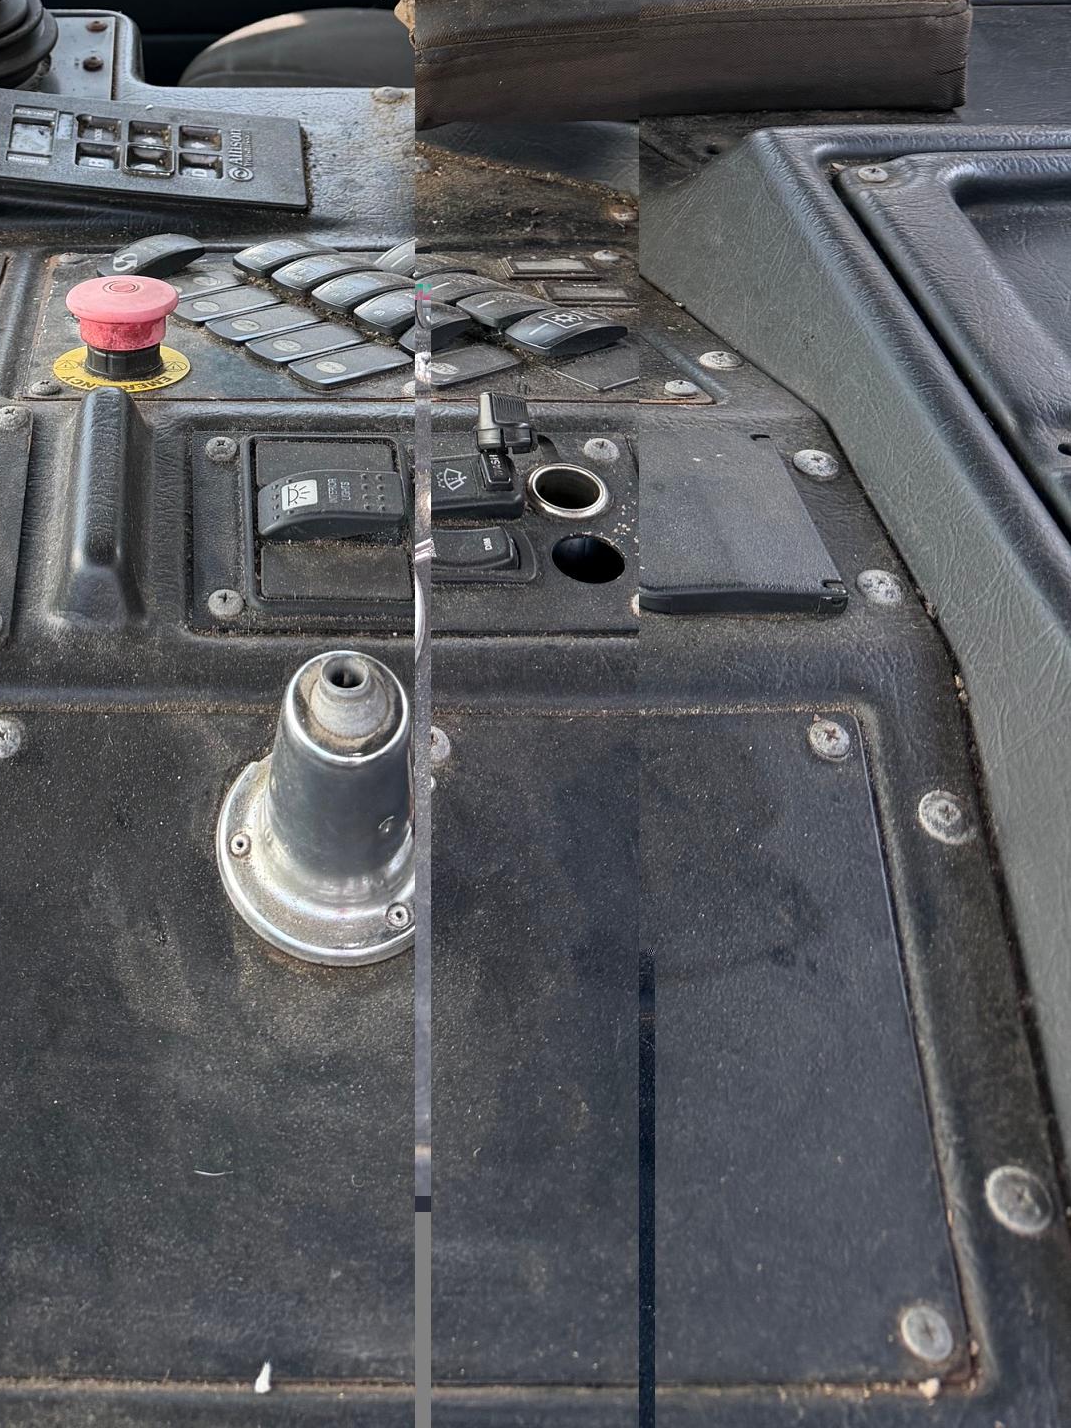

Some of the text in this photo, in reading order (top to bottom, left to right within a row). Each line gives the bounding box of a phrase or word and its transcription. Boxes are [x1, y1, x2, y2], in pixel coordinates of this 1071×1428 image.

[228, 129, 243, 165] Allison
[60, 375, 173, 392] EMERNCY
[482, 537, 493, 551] DIM
